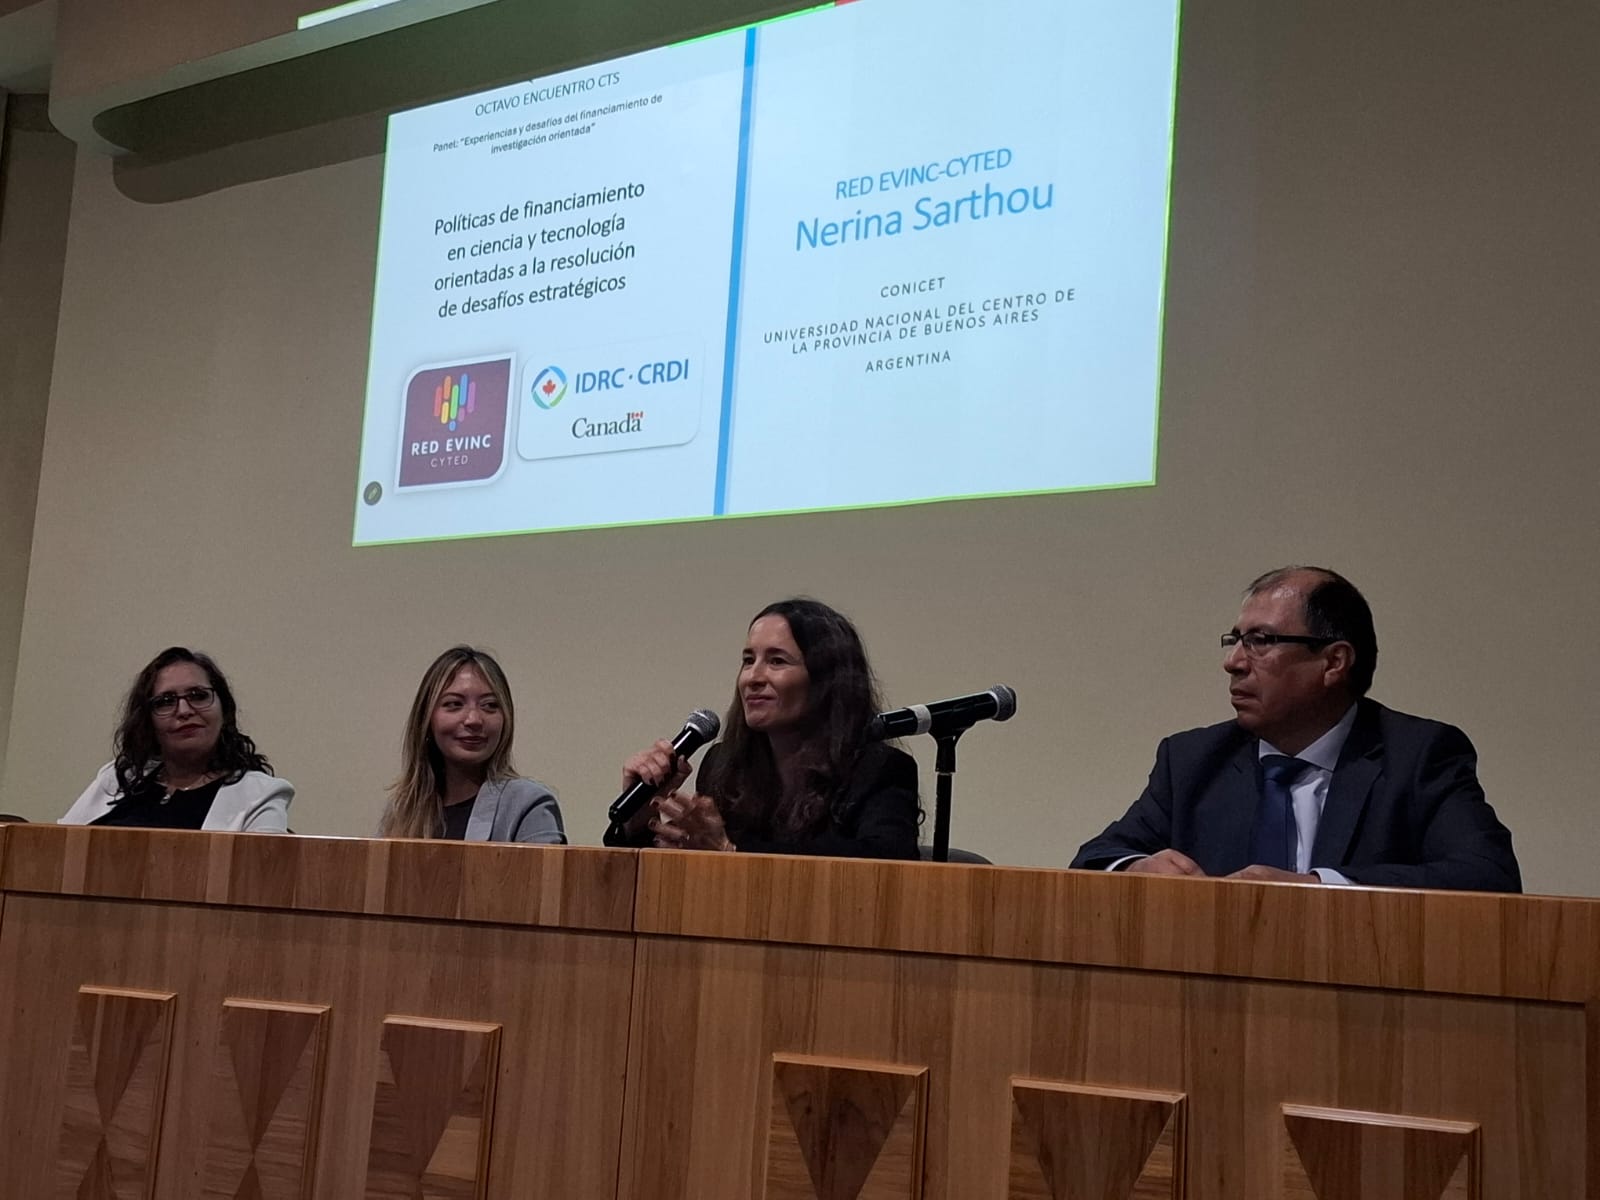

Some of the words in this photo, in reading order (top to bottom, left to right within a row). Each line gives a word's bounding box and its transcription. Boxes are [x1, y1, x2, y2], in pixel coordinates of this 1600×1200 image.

[475, 95, 520, 116] OCTAVO
[524, 79, 595, 106] ENCUENTRO
[599, 72, 620, 87] CTS
[433, 140, 458, 152] Panel:
[518, 125, 524, 136] y
[565, 112, 578, 124] del
[581, 97, 649, 120] financiamiento
[651, 93, 662, 105] de
[491, 134, 546, 154] investigación
[835, 176, 873, 200] RED
[879, 148, 1012, 191] EVINC-CYTED
[435, 212, 495, 235] Políticas
[500, 205, 518, 224] de
[524, 182, 644, 219] financiamiento
[796, 210, 902, 251] Nerina
[913, 183, 1053, 231] Sarthou
[448, 246, 465, 261] en
[470, 235, 522, 257] ciencia
[528, 232, 537, 250] y
[541, 214, 625, 244] tecnología
[435, 263, 514, 291] orientadas
[519, 262, 527, 276] a
[533, 258, 545, 275] la
[551, 243, 635, 272] resolución
[881, 277, 945, 298] CONICET
[439, 300, 457, 318] de
[529, 274, 626, 304] estratégicos
[763, 321, 858, 343] UNIVERSIDAD
[865, 307, 941, 329] NACIONAL
[948, 303, 974, 317] DEL
[982, 293, 1047, 311] CENTRO
[1055, 289, 1075, 302] DE
[793, 343, 807, 354] LA
[814, 330, 891, 351] PROVINCIA
[899, 326, 917, 339] DE
[924, 315, 986, 335] BUENOS
[993, 309, 1039, 325] AIRES
[576, 367, 624, 394] IDRC
[638, 359, 689, 384] CRDI
[866, 350, 951, 372] ARGENTINA
[411, 441, 438, 456] RED
[446, 434, 491, 452] EVINC
[571, 411, 643, 439] Canada
[431, 455, 468, 468] CYTED
